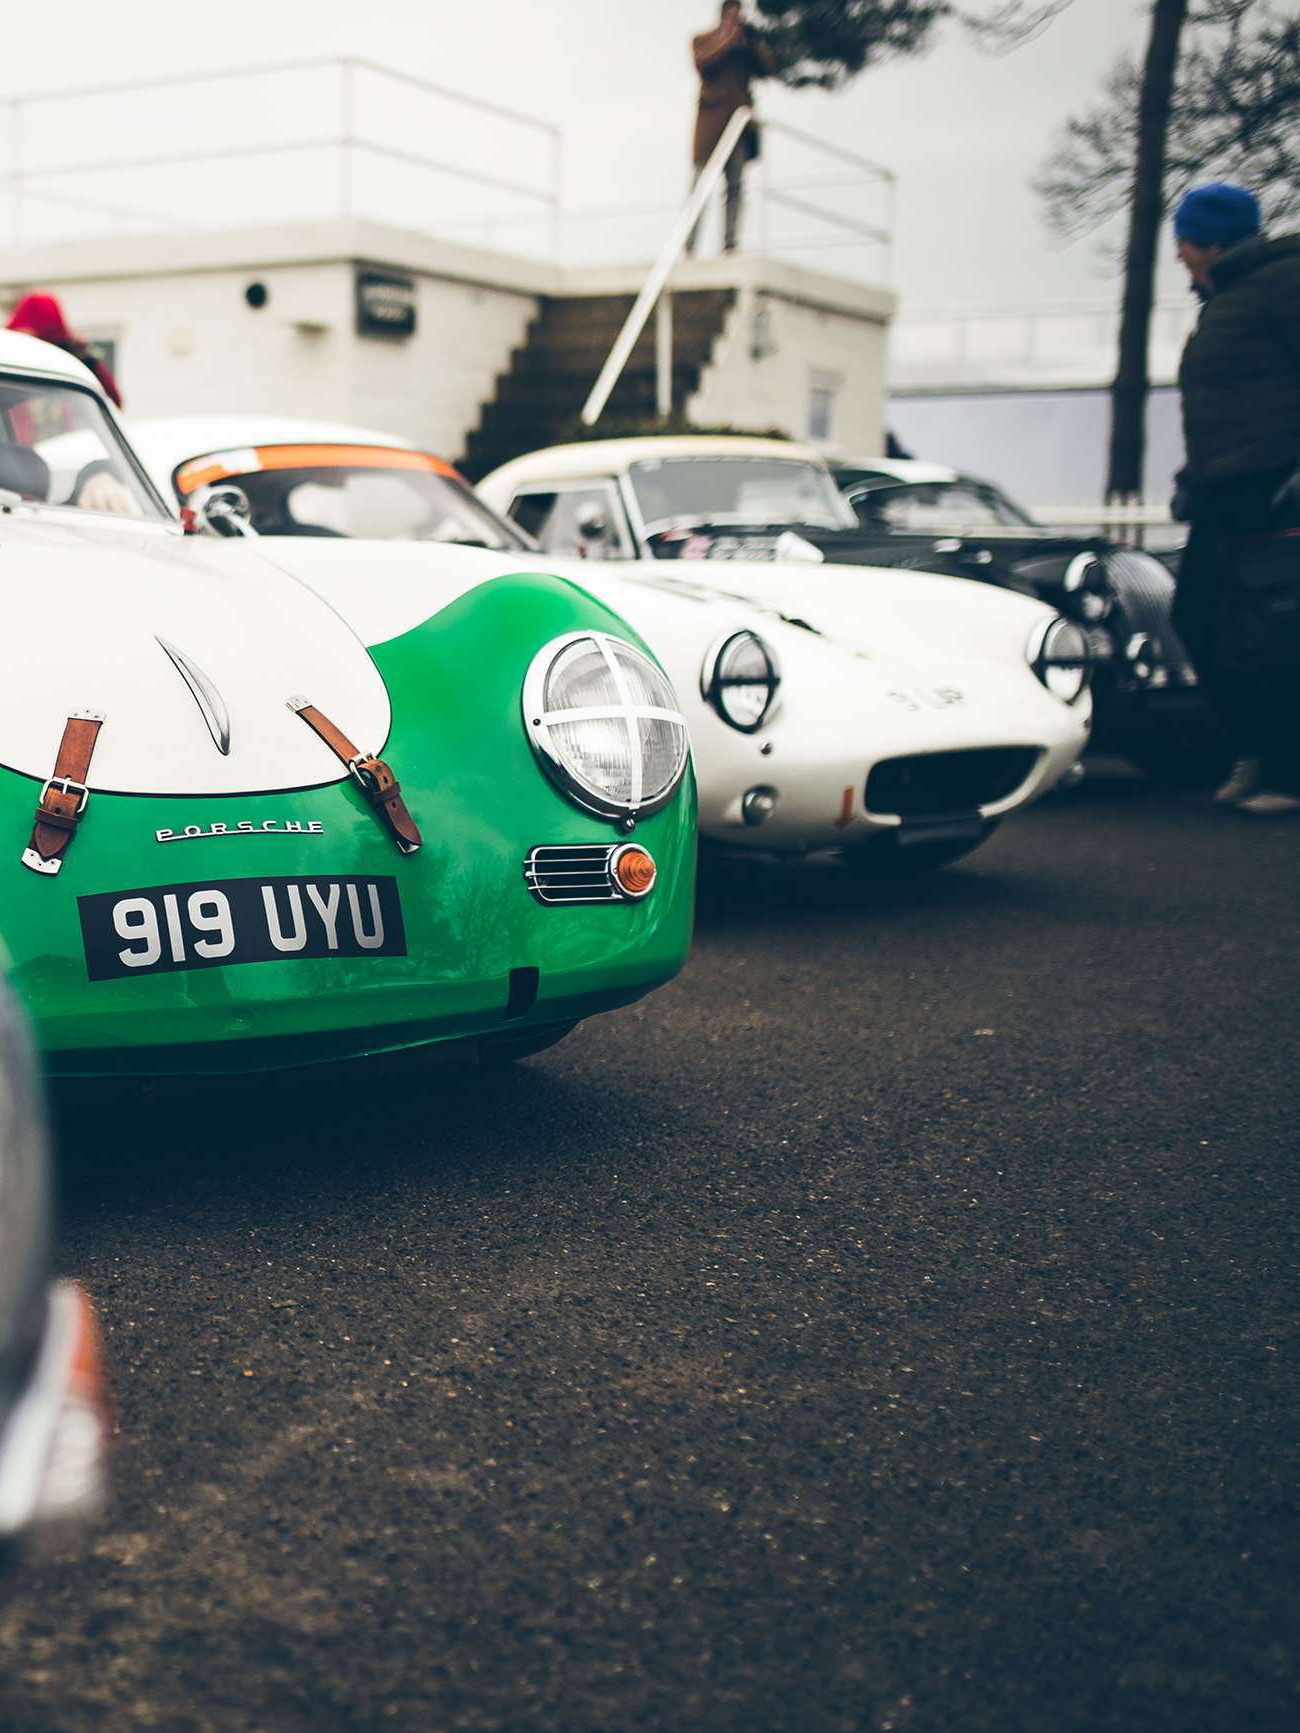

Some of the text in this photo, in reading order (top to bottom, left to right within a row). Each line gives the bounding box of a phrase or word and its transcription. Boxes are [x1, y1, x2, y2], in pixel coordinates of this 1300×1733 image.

[156, 820, 324, 842] PORSCHE
[112, 884, 385, 968] 919 UYU
